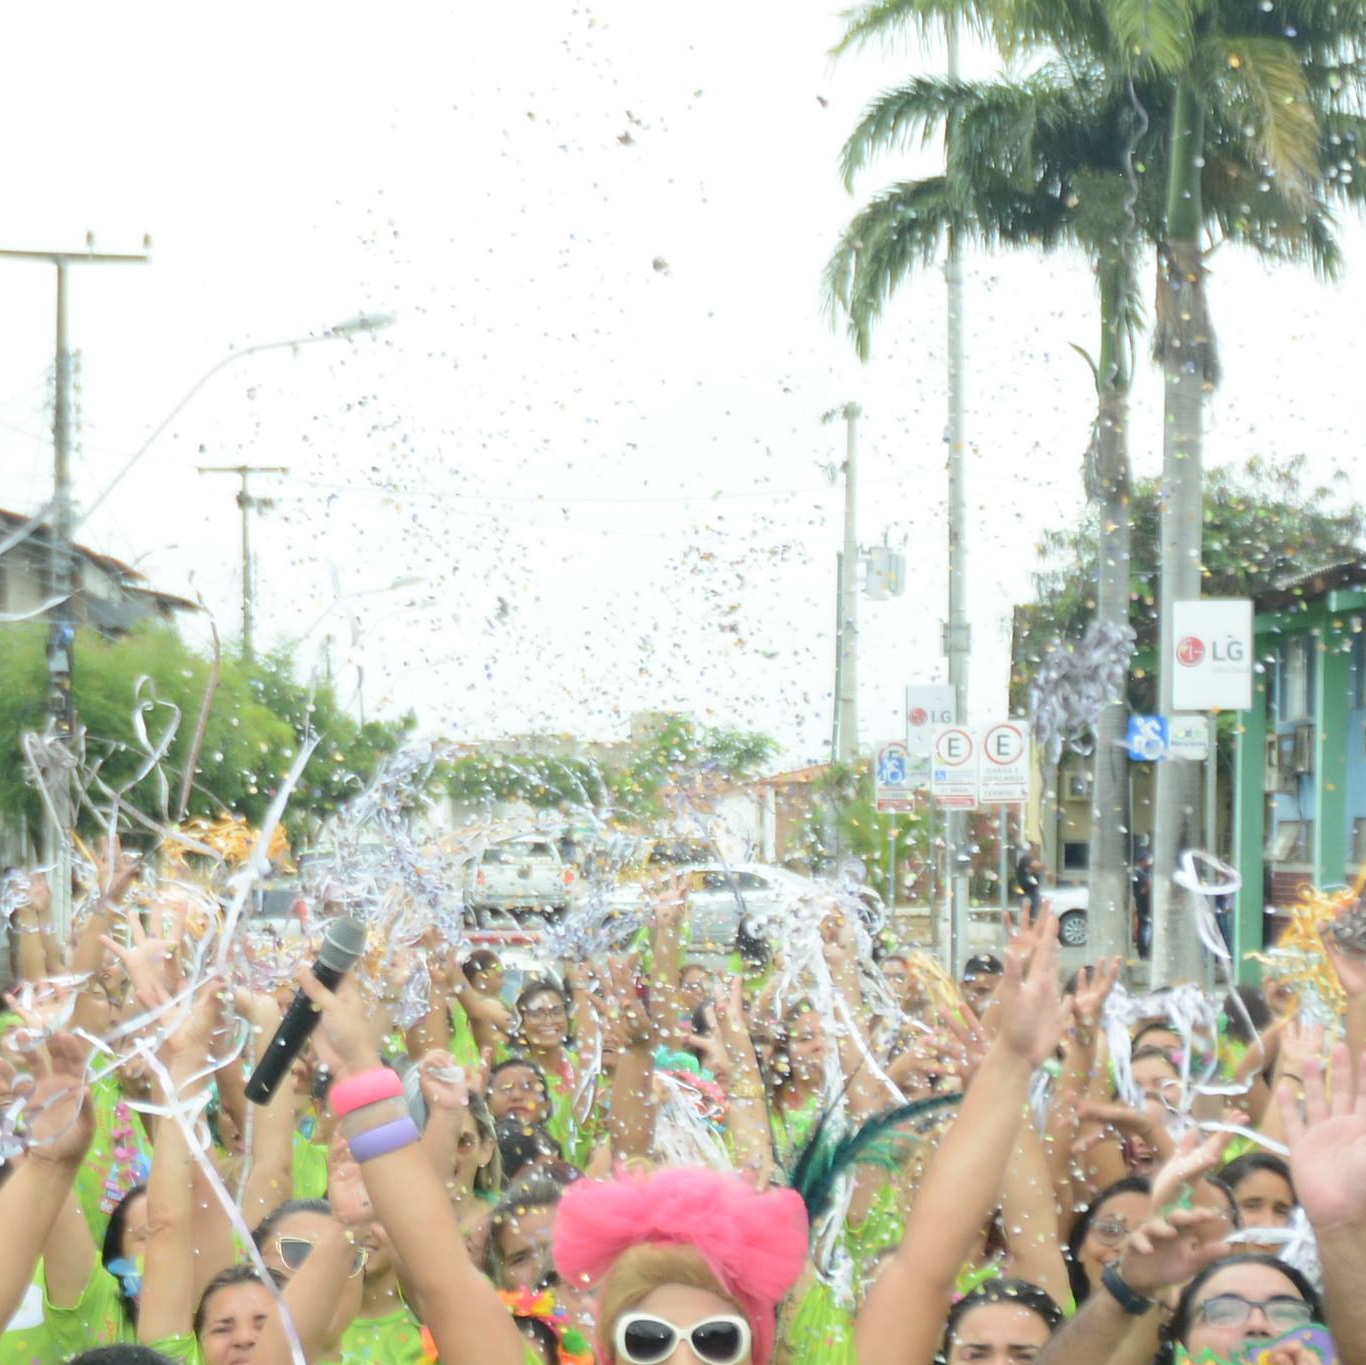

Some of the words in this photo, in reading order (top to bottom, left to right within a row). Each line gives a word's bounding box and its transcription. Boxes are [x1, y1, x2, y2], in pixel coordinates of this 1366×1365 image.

[1212, 641, 1243, 662] LG
[931, 710, 952, 724] LG
[948, 737, 961, 758] E
[997, 734, 1010, 756] E
